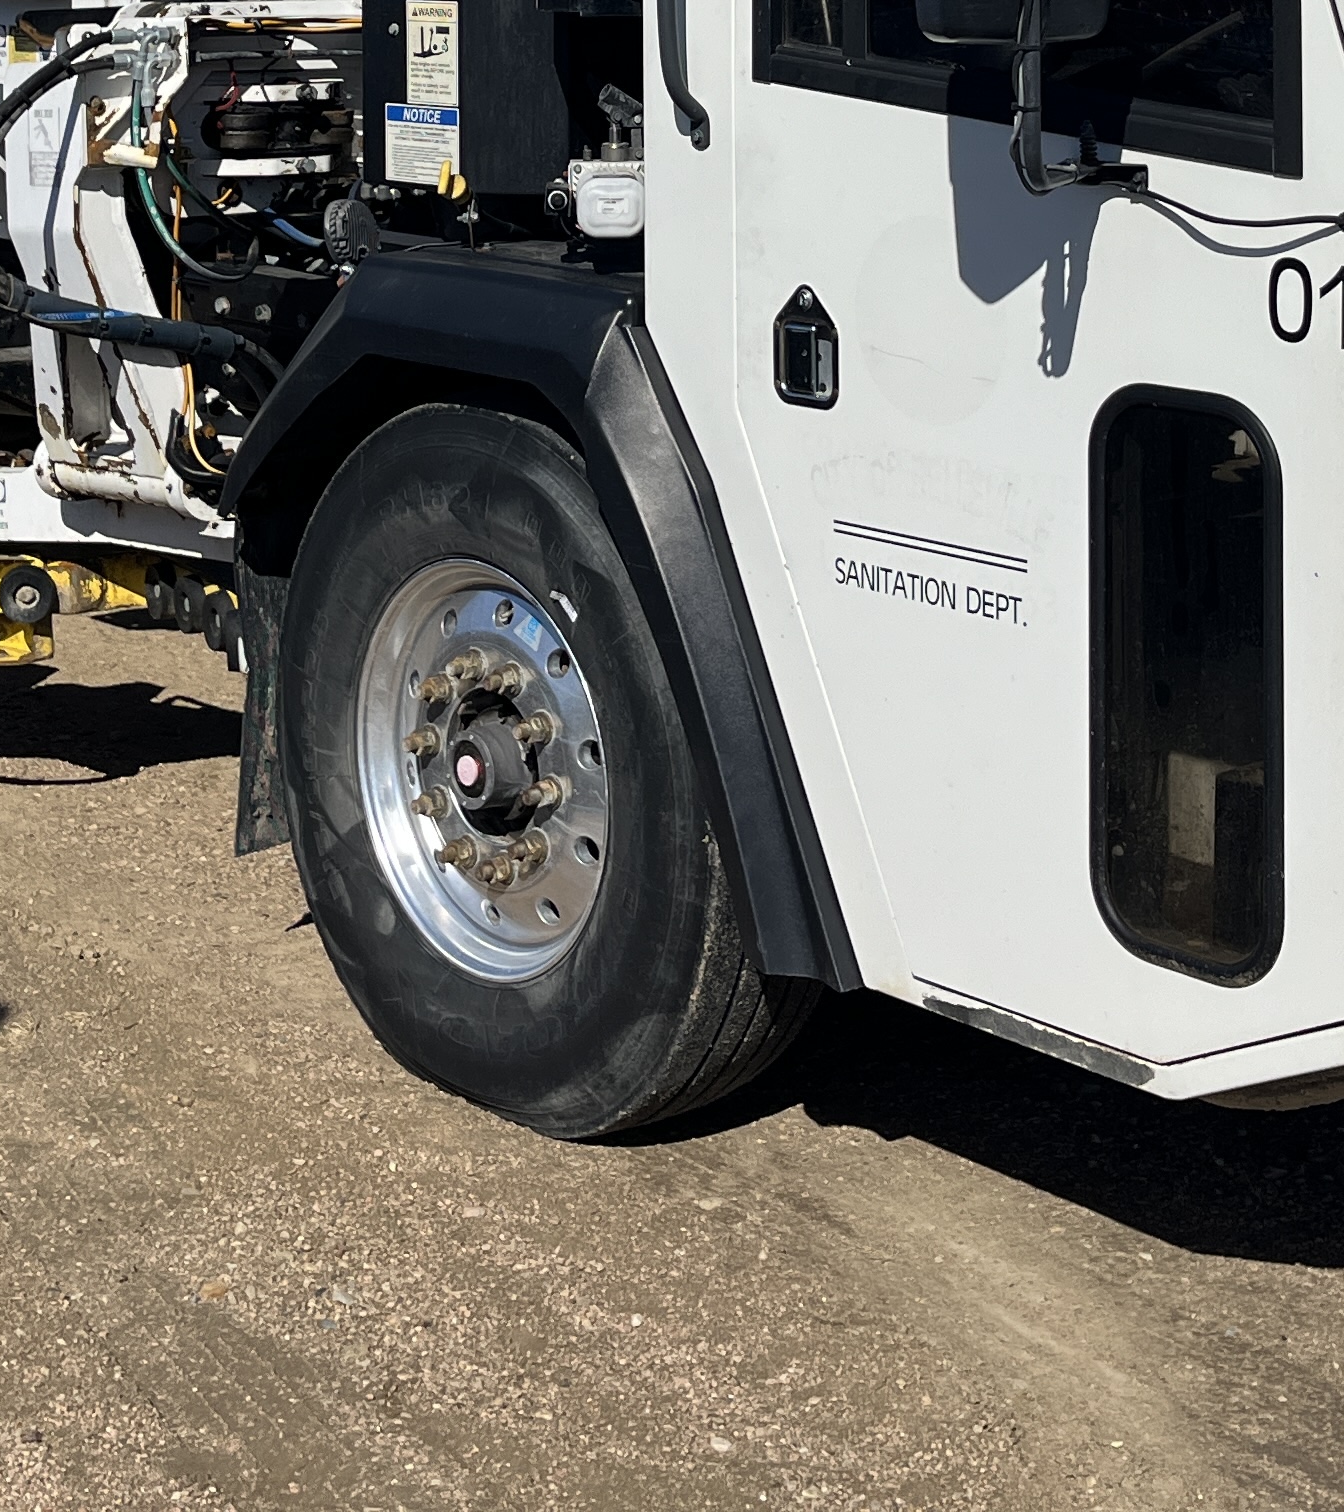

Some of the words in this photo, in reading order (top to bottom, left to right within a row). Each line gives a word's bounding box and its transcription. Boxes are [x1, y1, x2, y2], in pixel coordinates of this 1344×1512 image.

[418, 7, 453, 18] WARNING
[402, 107, 442, 124] NOTICE
[834, 557, 956, 610] SANITATION
[966, 586, 1027, 627] DEPT.
